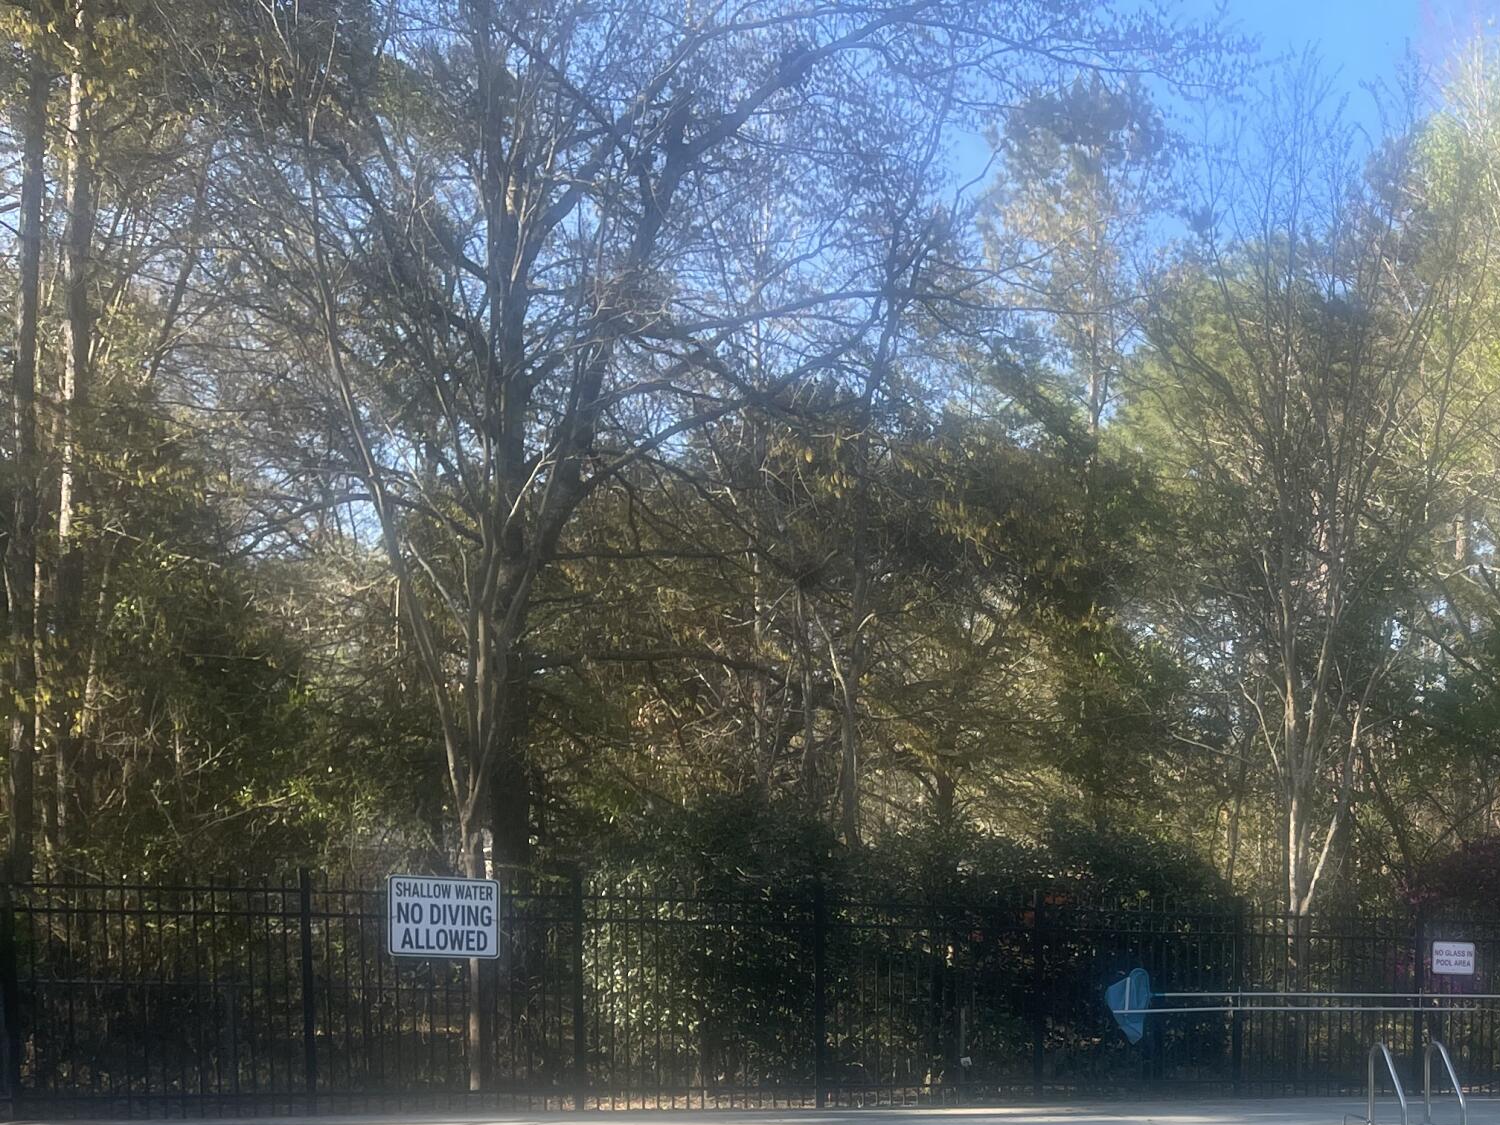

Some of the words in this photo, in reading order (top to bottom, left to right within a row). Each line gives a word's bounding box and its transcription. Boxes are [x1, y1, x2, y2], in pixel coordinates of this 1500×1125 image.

[395, 882, 451, 899] SHALLOW
[455, 884, 493, 901] WATER
[397, 902, 423, 925] NO
[430, 903, 492, 927] DIVING
[401, 927, 487, 952] ALLOWED
[1434, 949, 1444, 957] NO
[1445, 950, 1465, 958] GLASS
[1436, 959, 1453, 967] POOL
[1454, 960, 1471, 968] AREA
